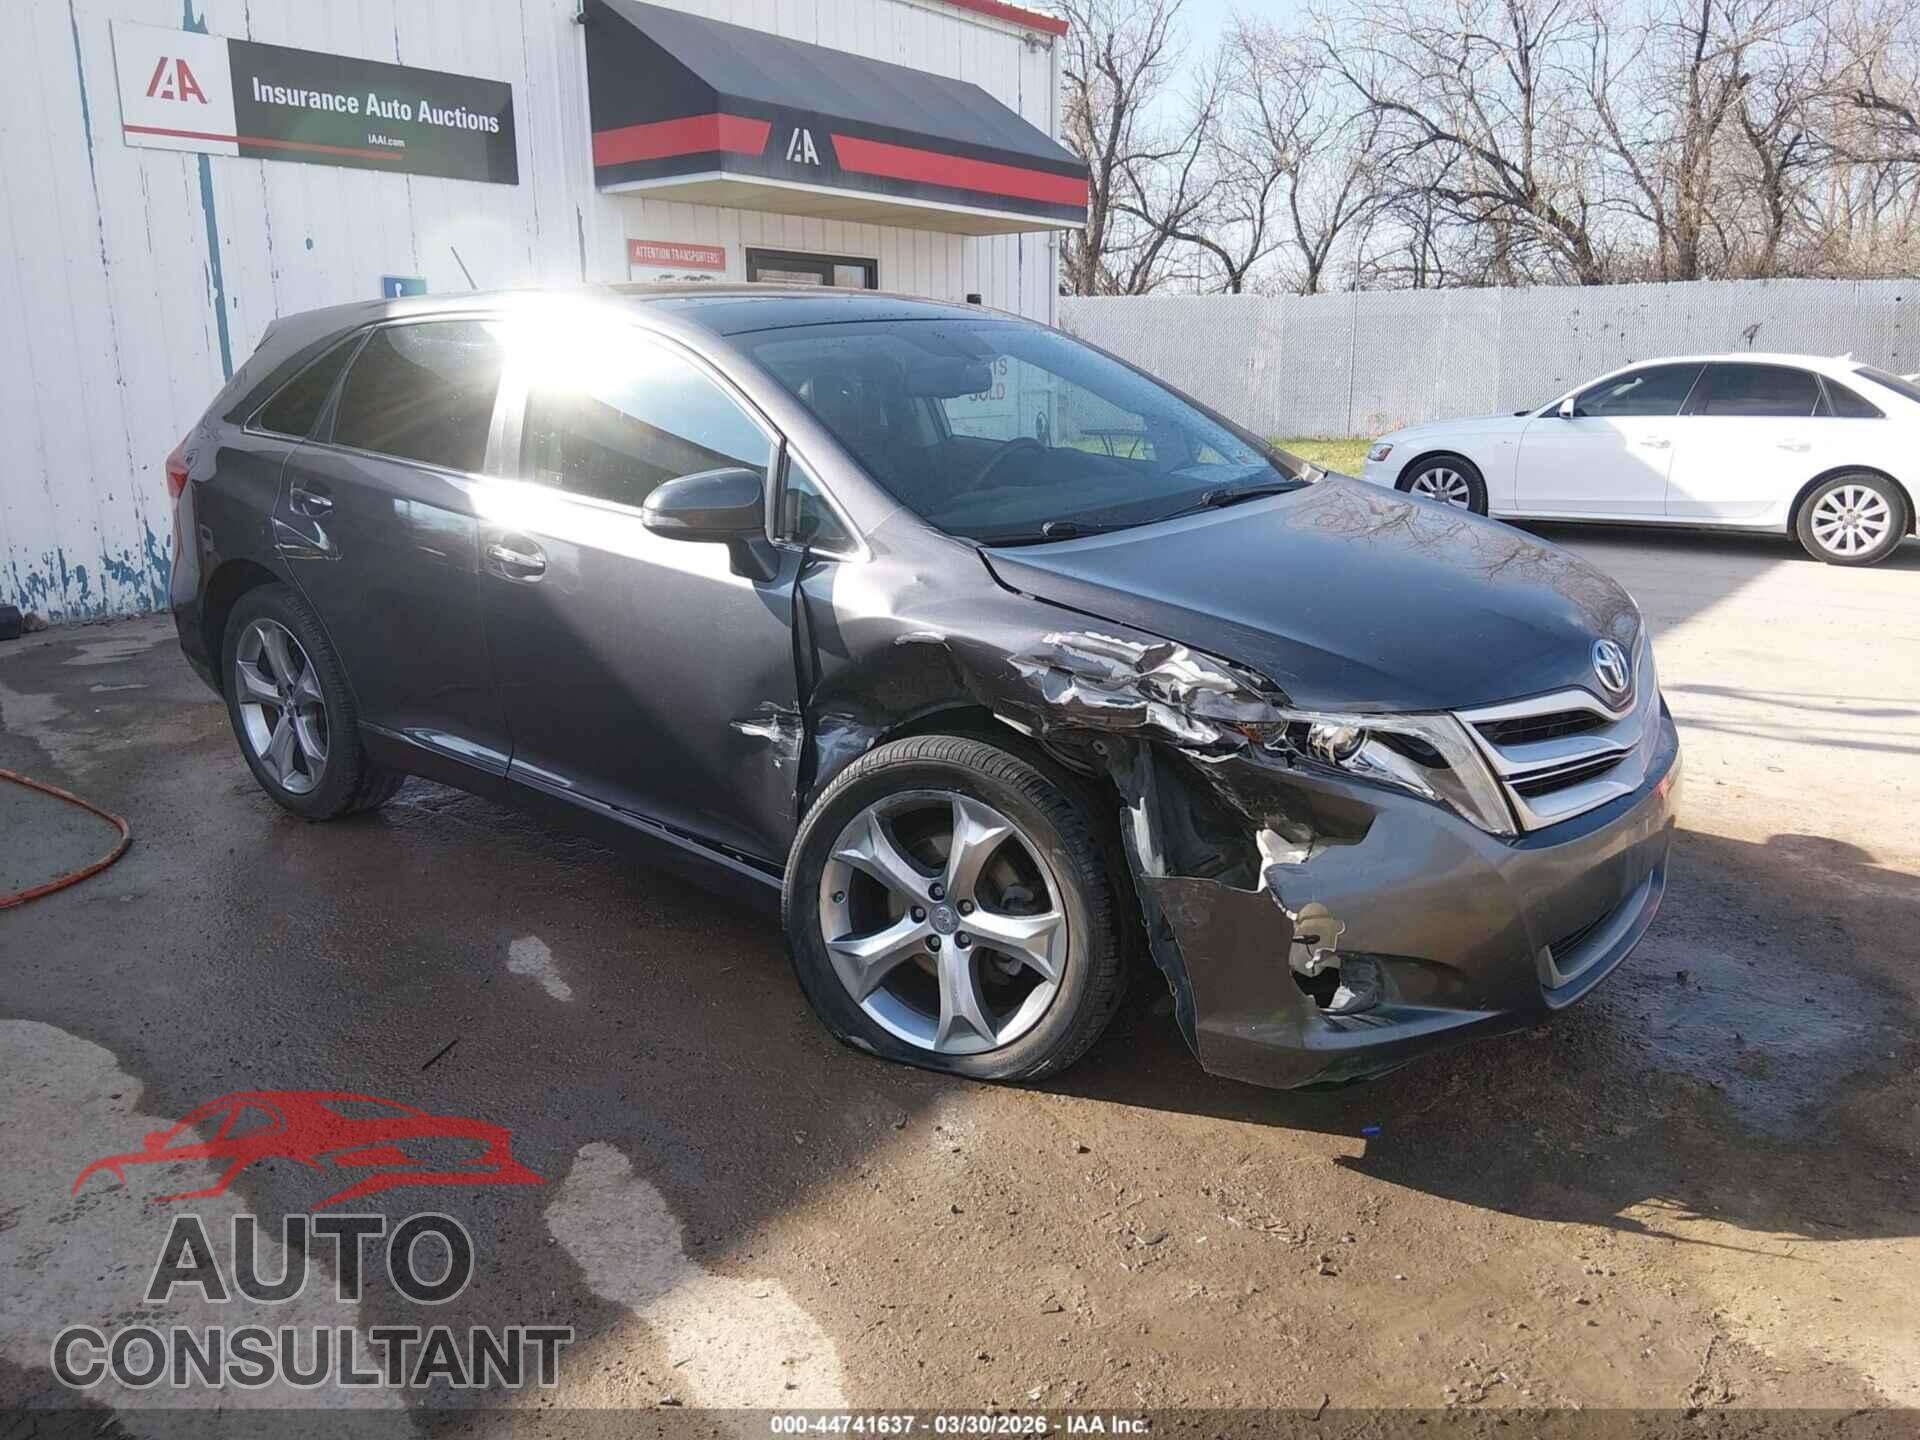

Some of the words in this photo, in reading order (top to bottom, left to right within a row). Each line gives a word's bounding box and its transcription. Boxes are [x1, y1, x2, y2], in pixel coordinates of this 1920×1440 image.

[252, 76, 359, 115] Insurance
[366, 93, 412, 121] Auto
[417, 101, 500, 134] Auctions
[368, 133, 405, 147] IAAI.com
[635, 245, 670, 260] ATTENTION
